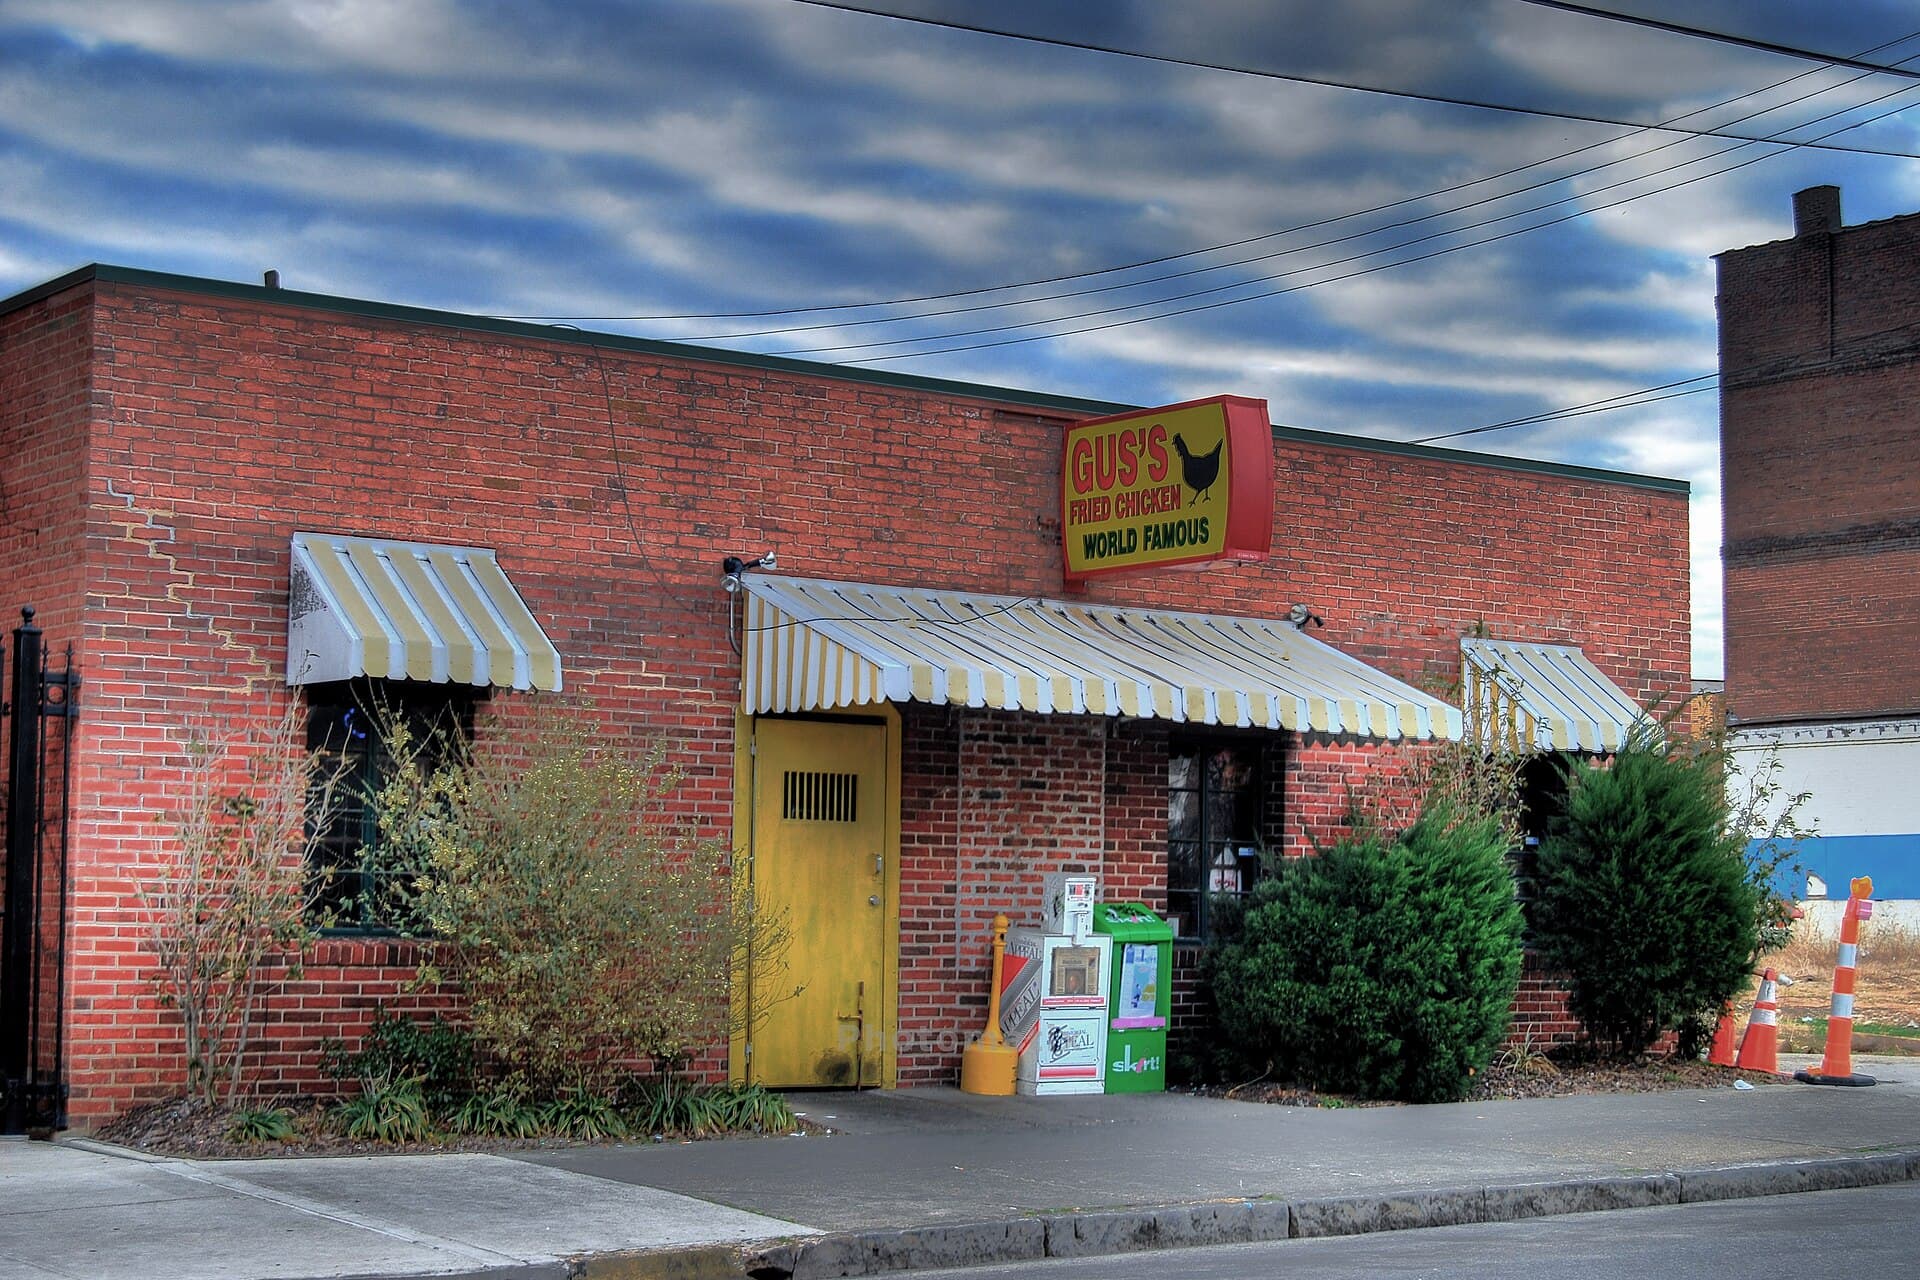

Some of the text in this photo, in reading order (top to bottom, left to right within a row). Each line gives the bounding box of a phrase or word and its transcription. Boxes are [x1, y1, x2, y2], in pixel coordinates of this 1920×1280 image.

[1071, 424, 1169, 495] GUS'S
[1069, 484, 1181, 526] FRIED CHICKEN
[1083, 517, 1209, 560] WORLD FAMOUS
[1000, 983, 1041, 1034] PPEAL
